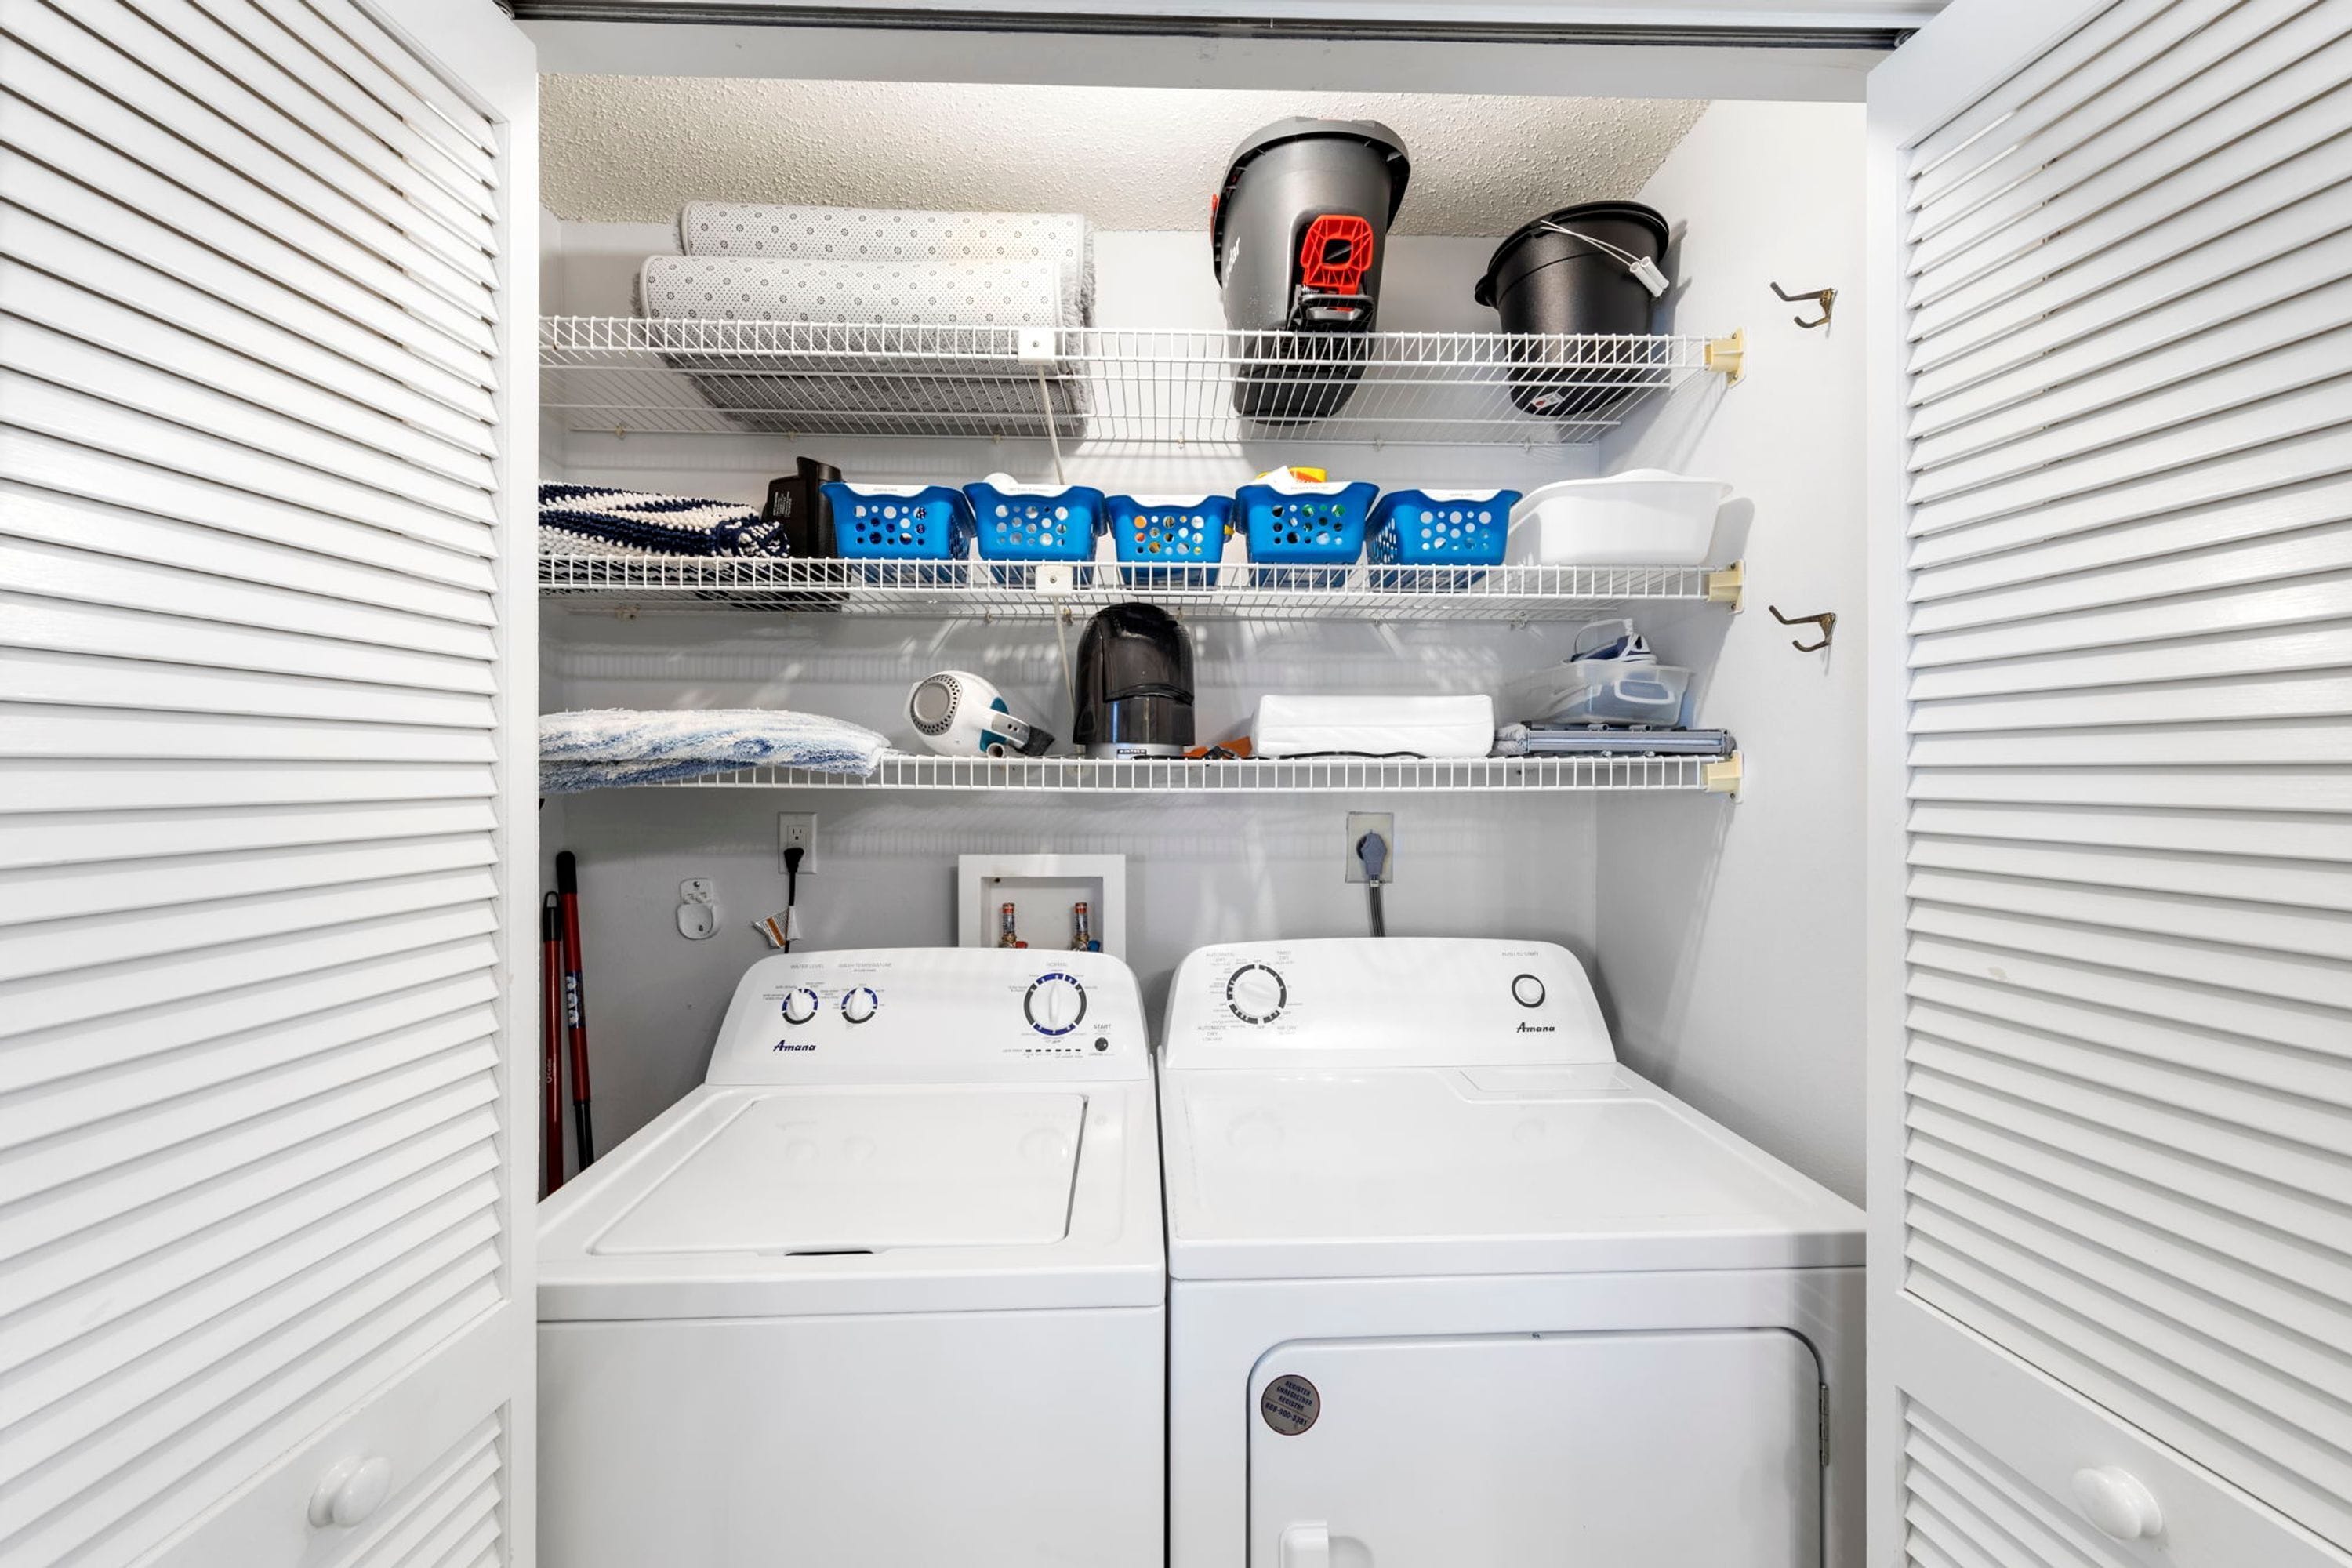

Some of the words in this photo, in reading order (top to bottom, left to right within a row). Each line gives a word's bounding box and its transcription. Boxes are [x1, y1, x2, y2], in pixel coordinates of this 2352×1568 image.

[1516, 1022, 1556, 1033] Amana
[773, 1040, 816, 1052] Amana
[1285, 1380, 1312, 1396] REGISTER
